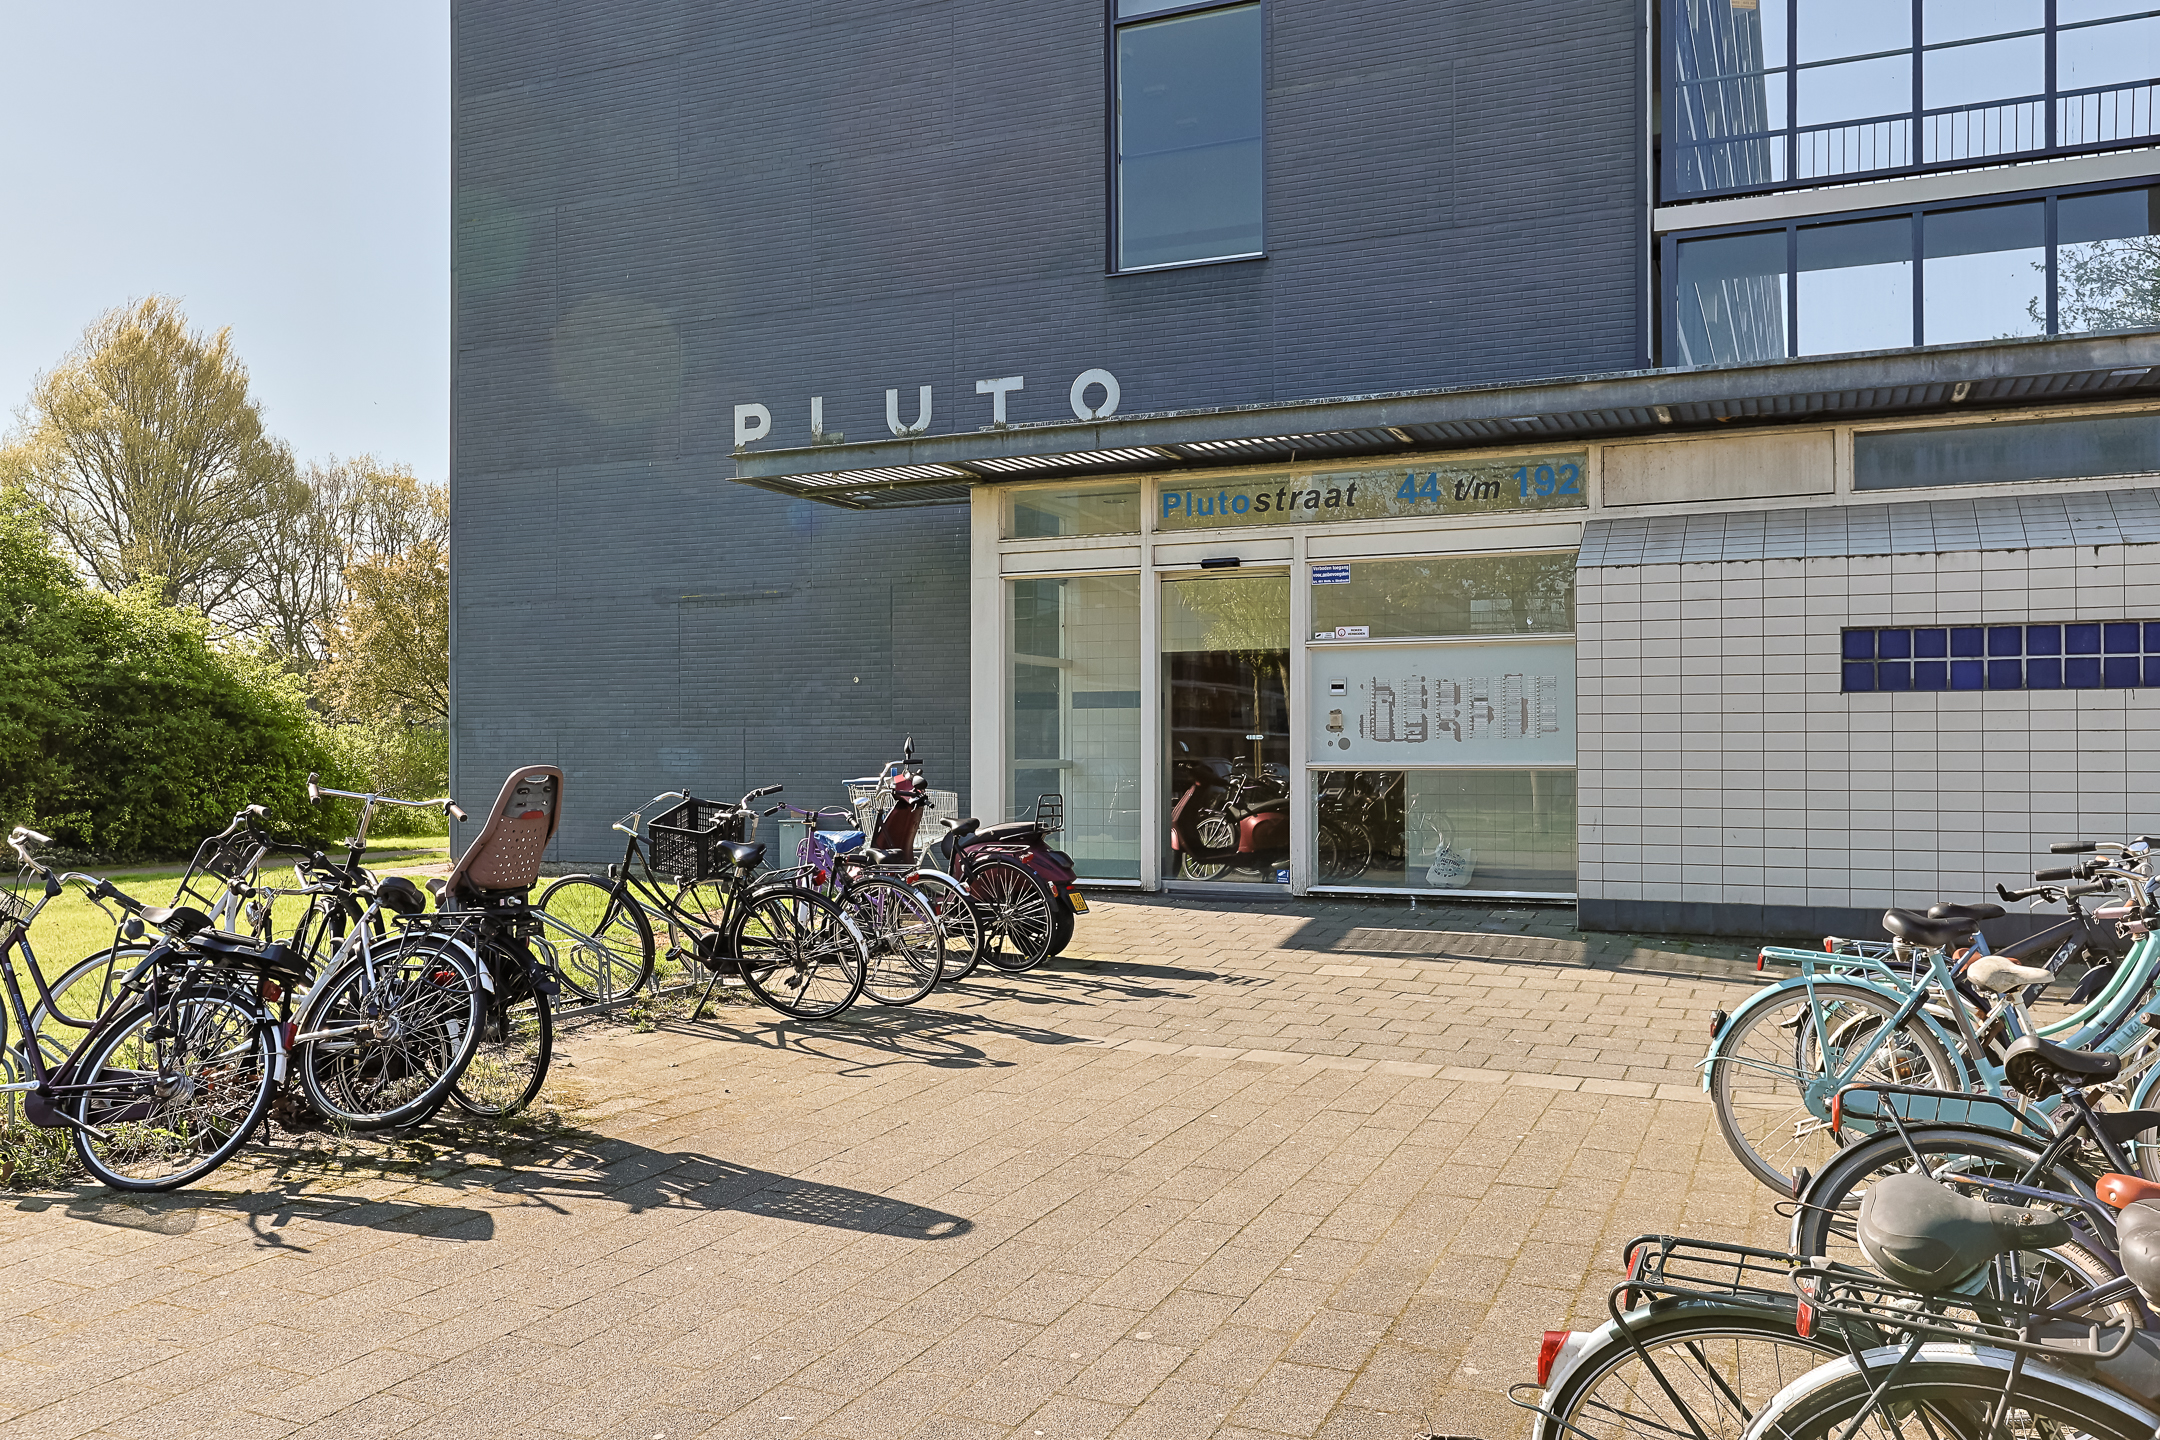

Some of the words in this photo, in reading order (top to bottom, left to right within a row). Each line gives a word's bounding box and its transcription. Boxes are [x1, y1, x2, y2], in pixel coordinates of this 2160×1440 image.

[734, 368, 1121, 452] PLUTO
[1162, 481, 1358, 518] Plutostraat
[1397, 472, 1442, 504] 44
[1454, 476, 1501, 501] t/m
[1513, 463, 1580, 498] 192
